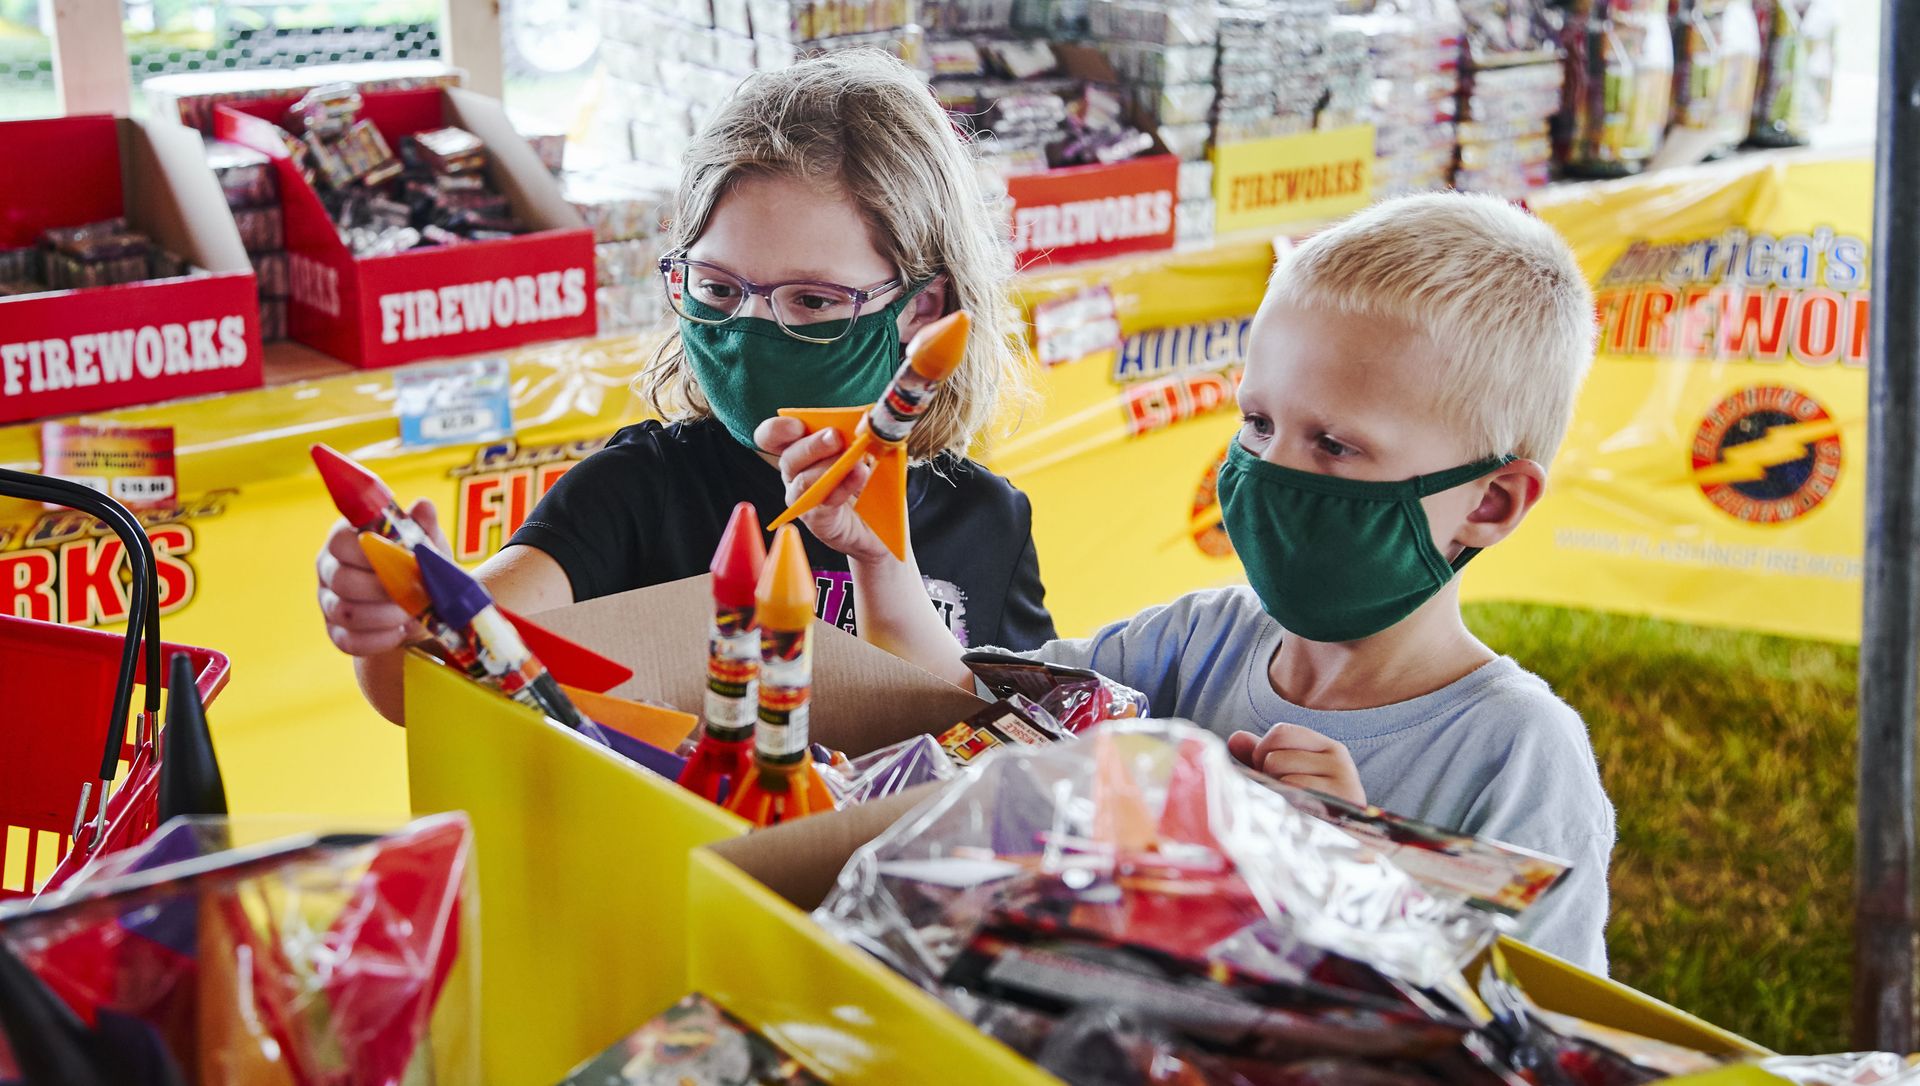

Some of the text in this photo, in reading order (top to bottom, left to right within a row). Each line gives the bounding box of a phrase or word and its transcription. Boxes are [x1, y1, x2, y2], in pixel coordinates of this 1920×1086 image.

[1015, 189, 1173, 250] FIREWORKS
[1230, 160, 1363, 213] FIREWORKS
[379, 267, 587, 344] FIREWORKS
[1, 315, 247, 396] FIREWORKS
